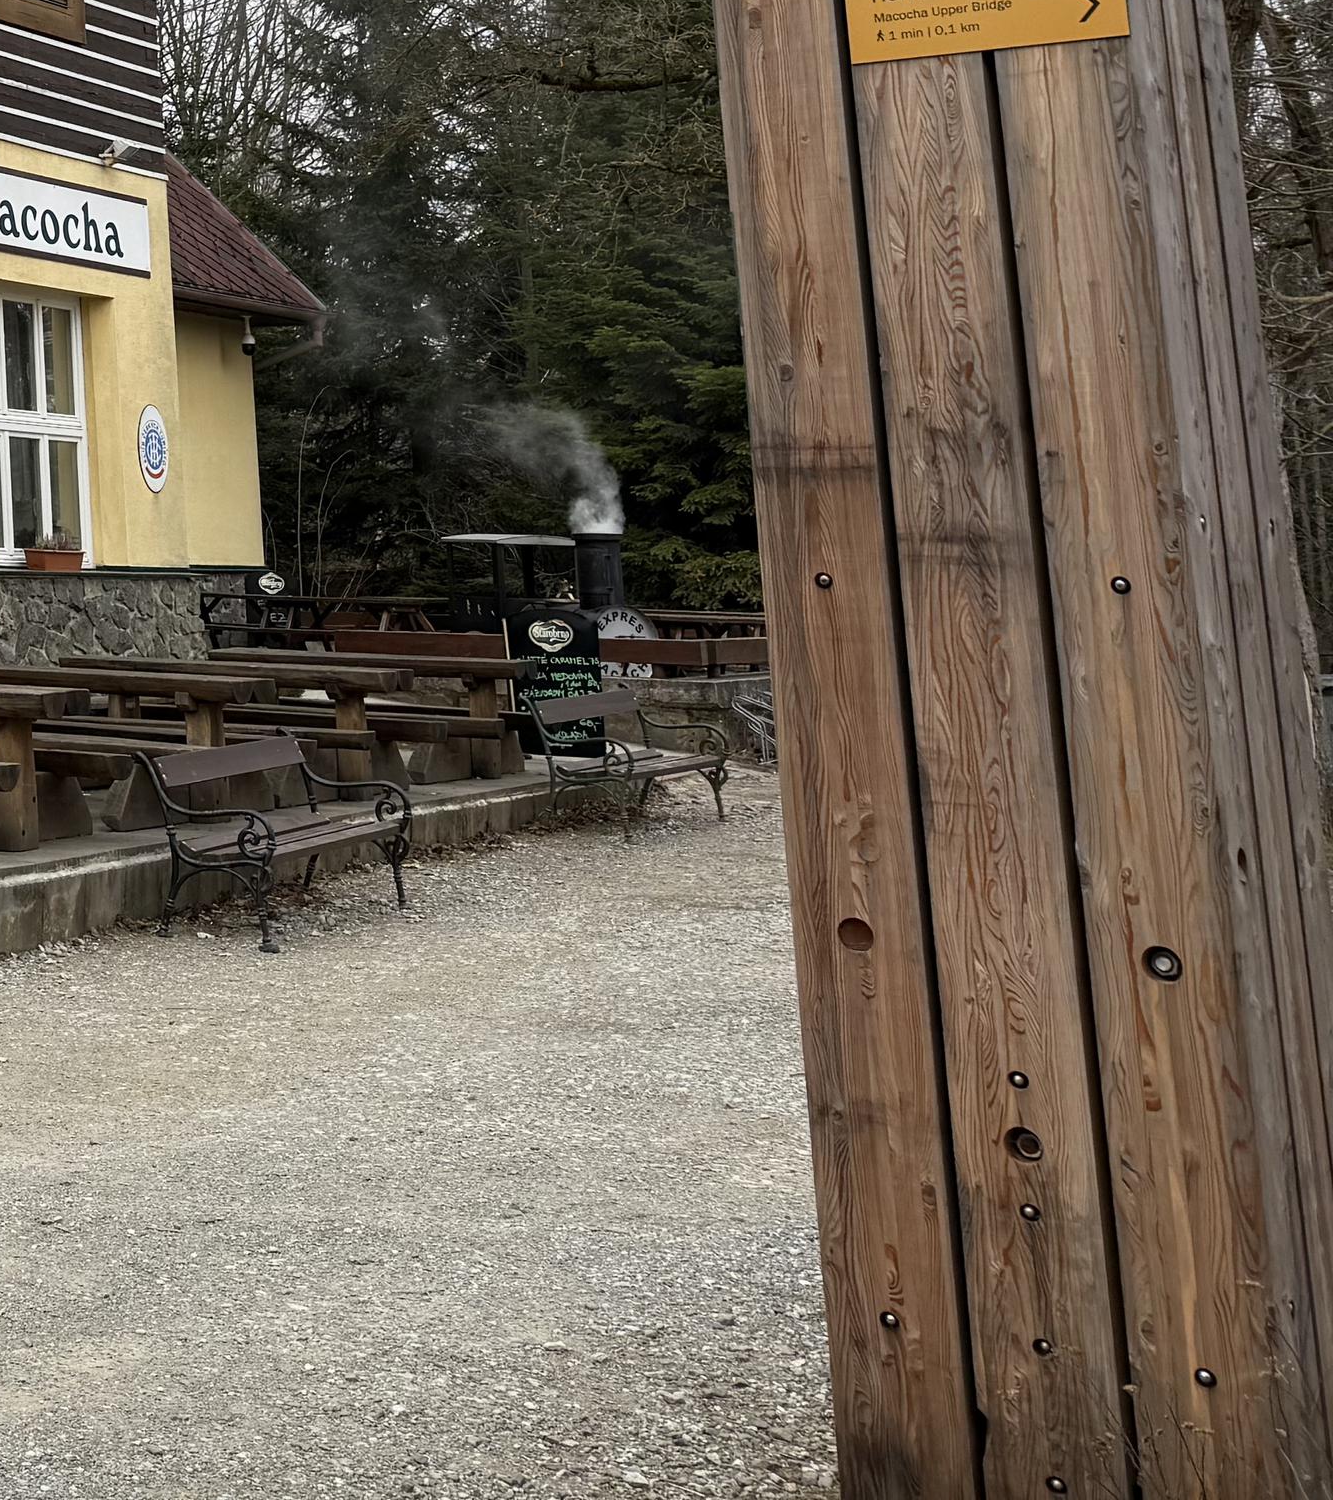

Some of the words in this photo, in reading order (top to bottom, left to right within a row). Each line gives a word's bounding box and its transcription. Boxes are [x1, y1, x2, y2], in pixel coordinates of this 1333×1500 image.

[874, 8, 928, 23] Macocha
[932, 3, 968, 18] Upper
[971, 0, 1012, 12] Bridge
[889, 30, 897, 40] 1
[901, 28, 924, 39] min
[961, 22, 980, 33] km
[598, 611, 644, 634] EXPRES
